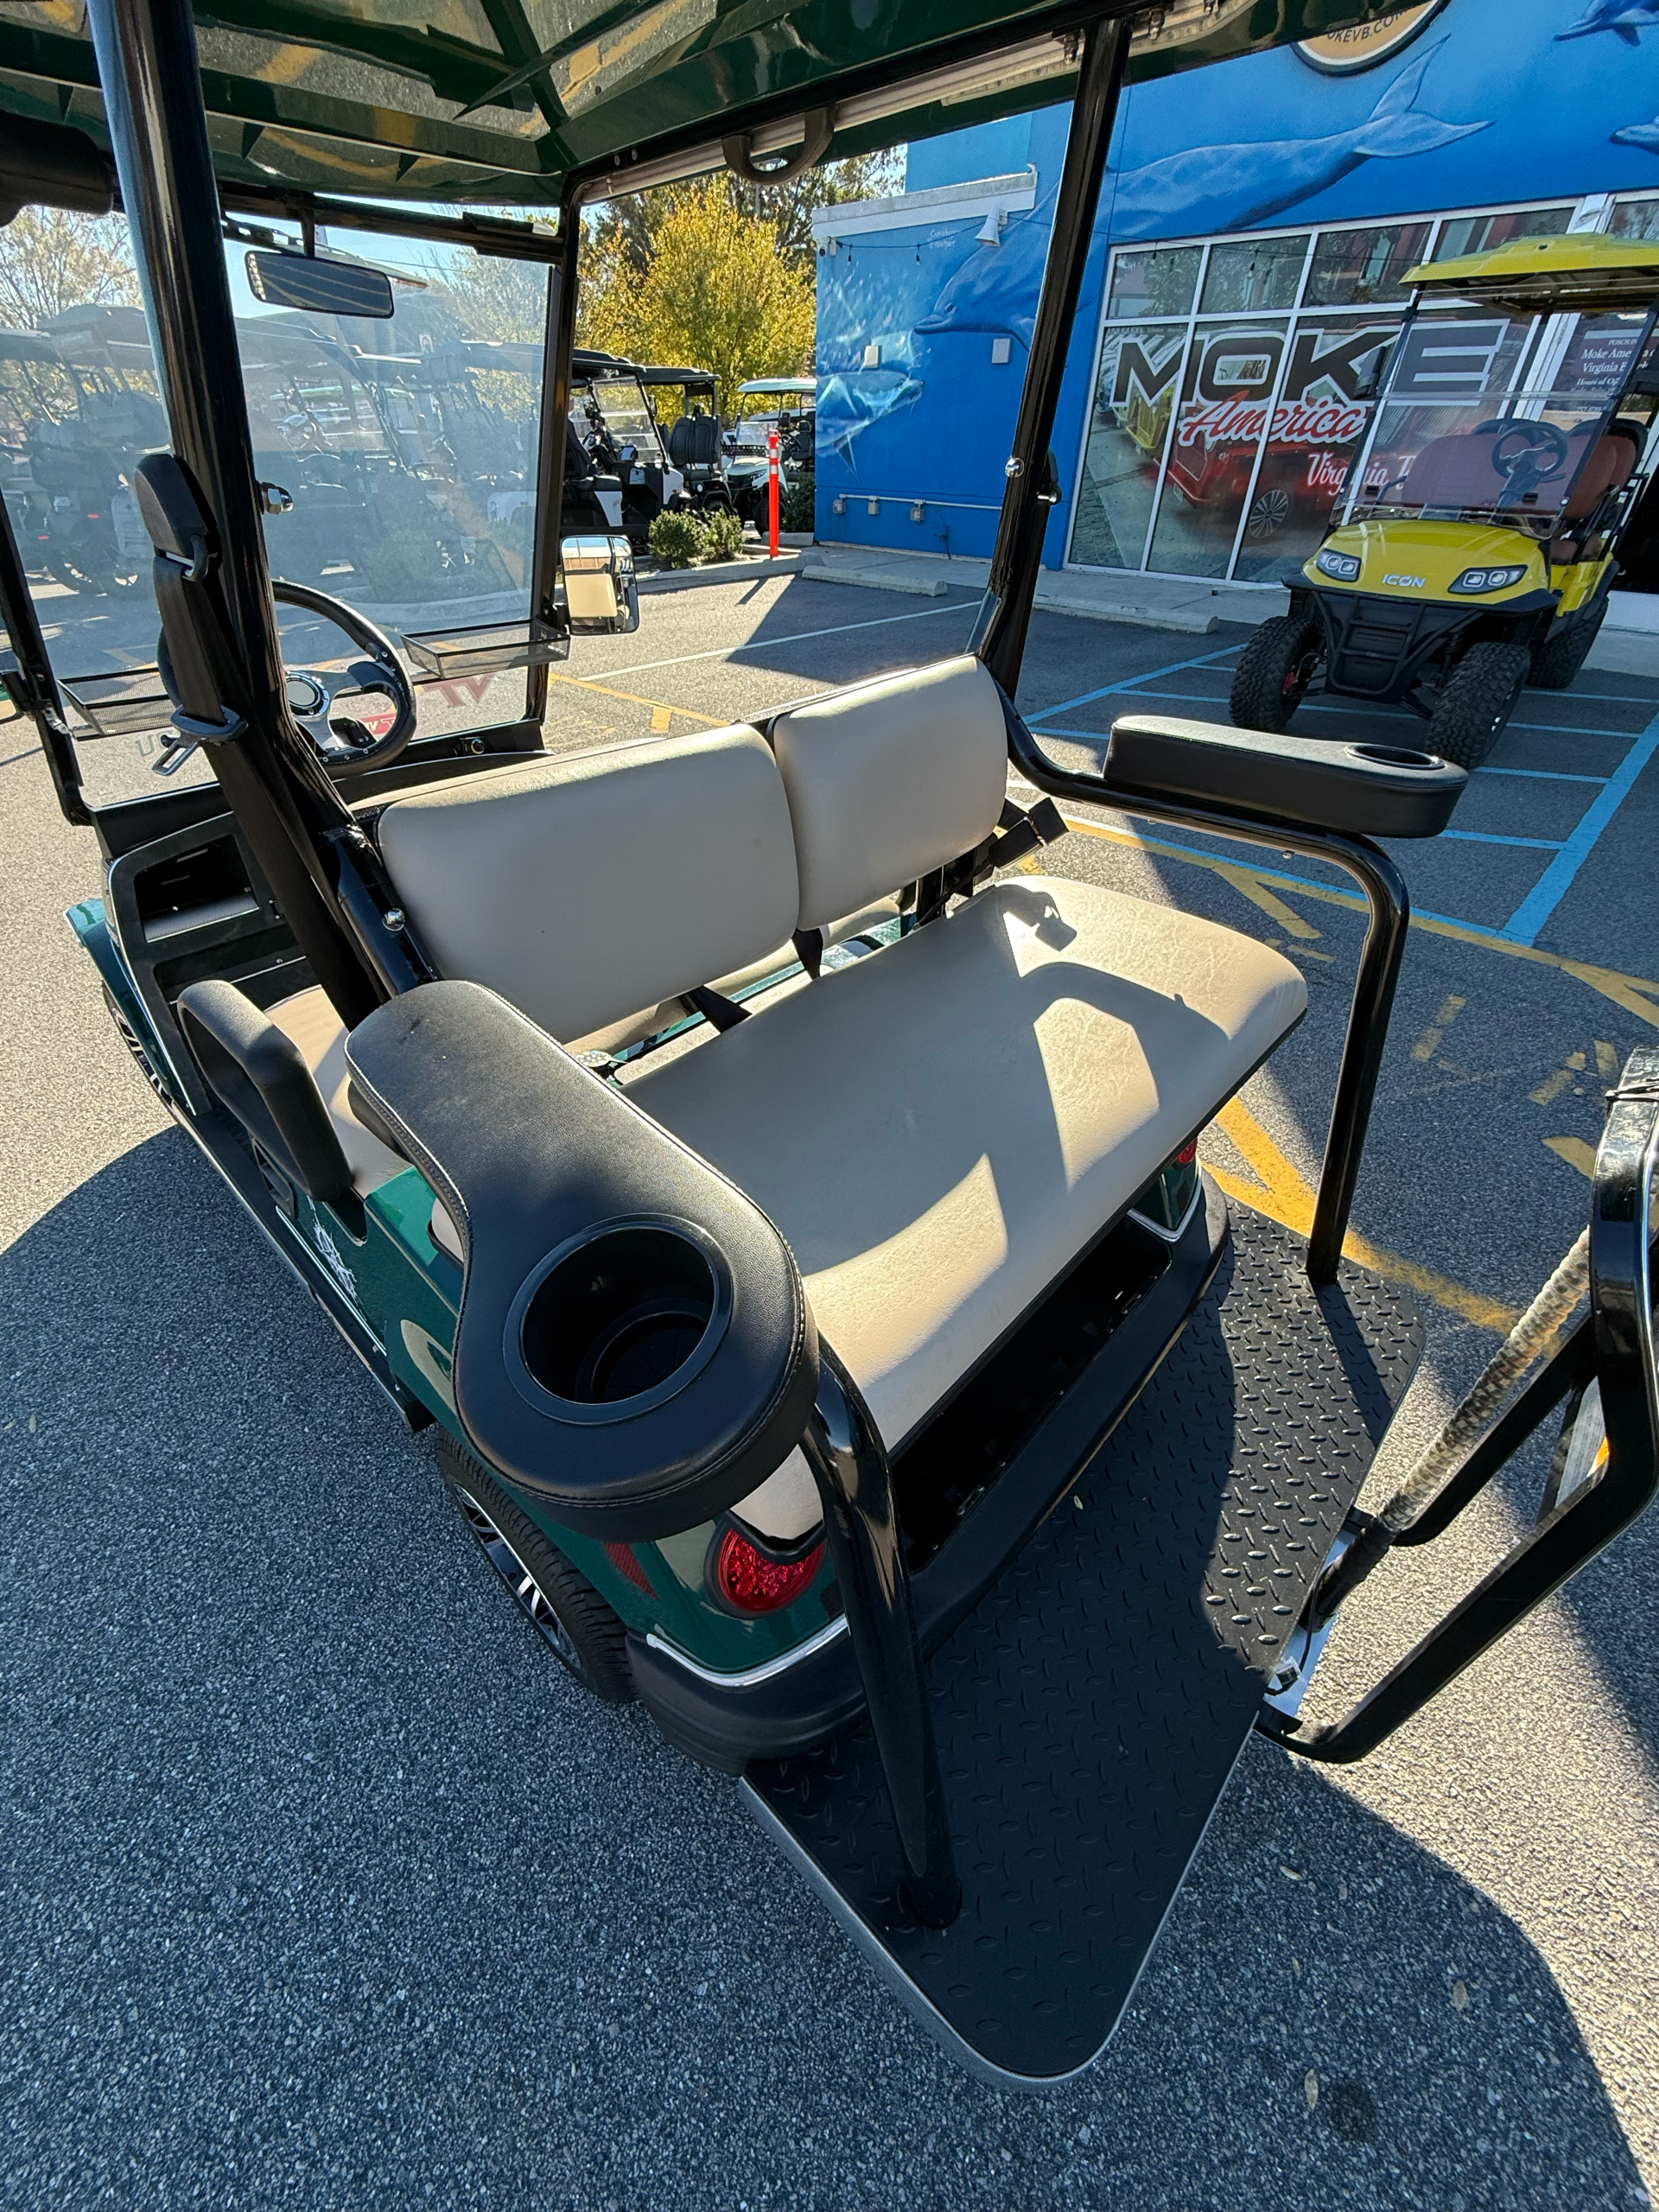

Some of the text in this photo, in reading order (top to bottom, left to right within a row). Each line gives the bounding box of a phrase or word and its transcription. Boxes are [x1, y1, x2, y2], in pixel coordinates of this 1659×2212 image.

[1581, 348, 1607, 359] Moke
[1110, 319, 1510, 406] MOKE
[1583, 362, 1618, 374] Virginia
[1180, 389, 1366, 446] America
[1382, 574, 1426, 588] ICON
